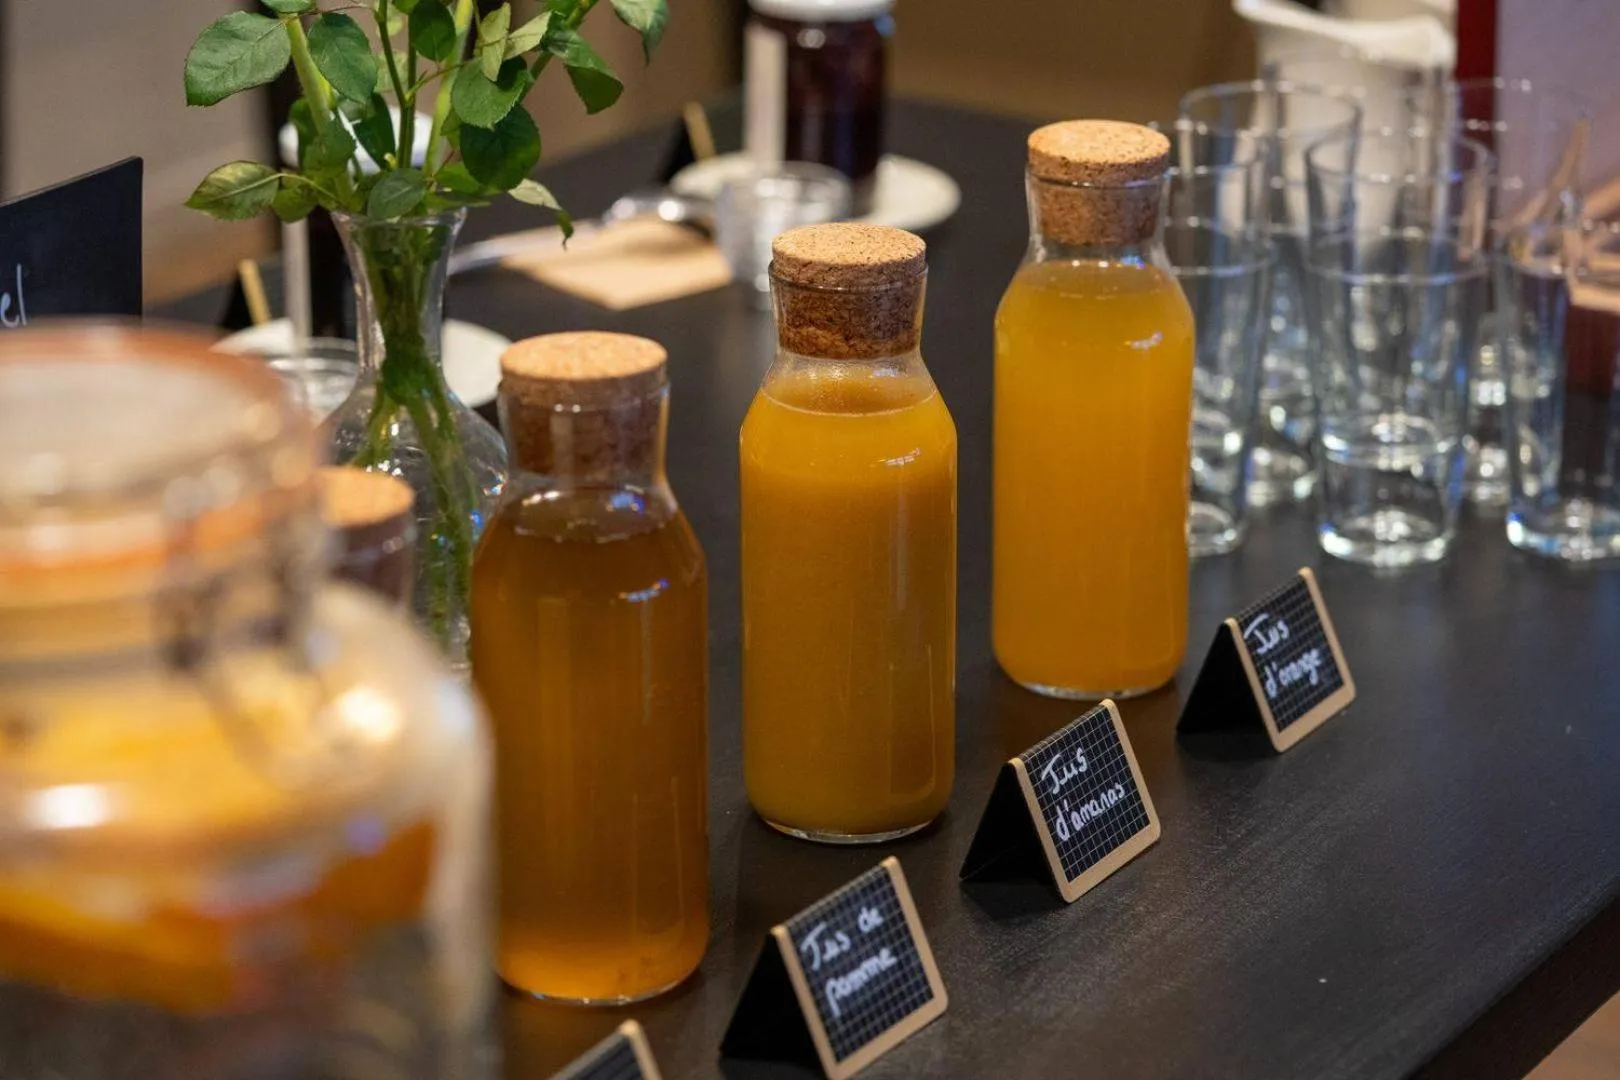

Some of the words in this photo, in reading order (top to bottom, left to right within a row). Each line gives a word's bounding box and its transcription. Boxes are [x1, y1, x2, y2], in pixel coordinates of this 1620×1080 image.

[1243, 613, 1289, 655] Jus
[1264, 649, 1322, 698] d'orange
[1041, 747, 1088, 795] Jus
[1055, 782, 1125, 841] d'ananas
[800, 921, 852, 971] Jus
[857, 906, 884, 933] de
[825, 948, 897, 1018] pomme
